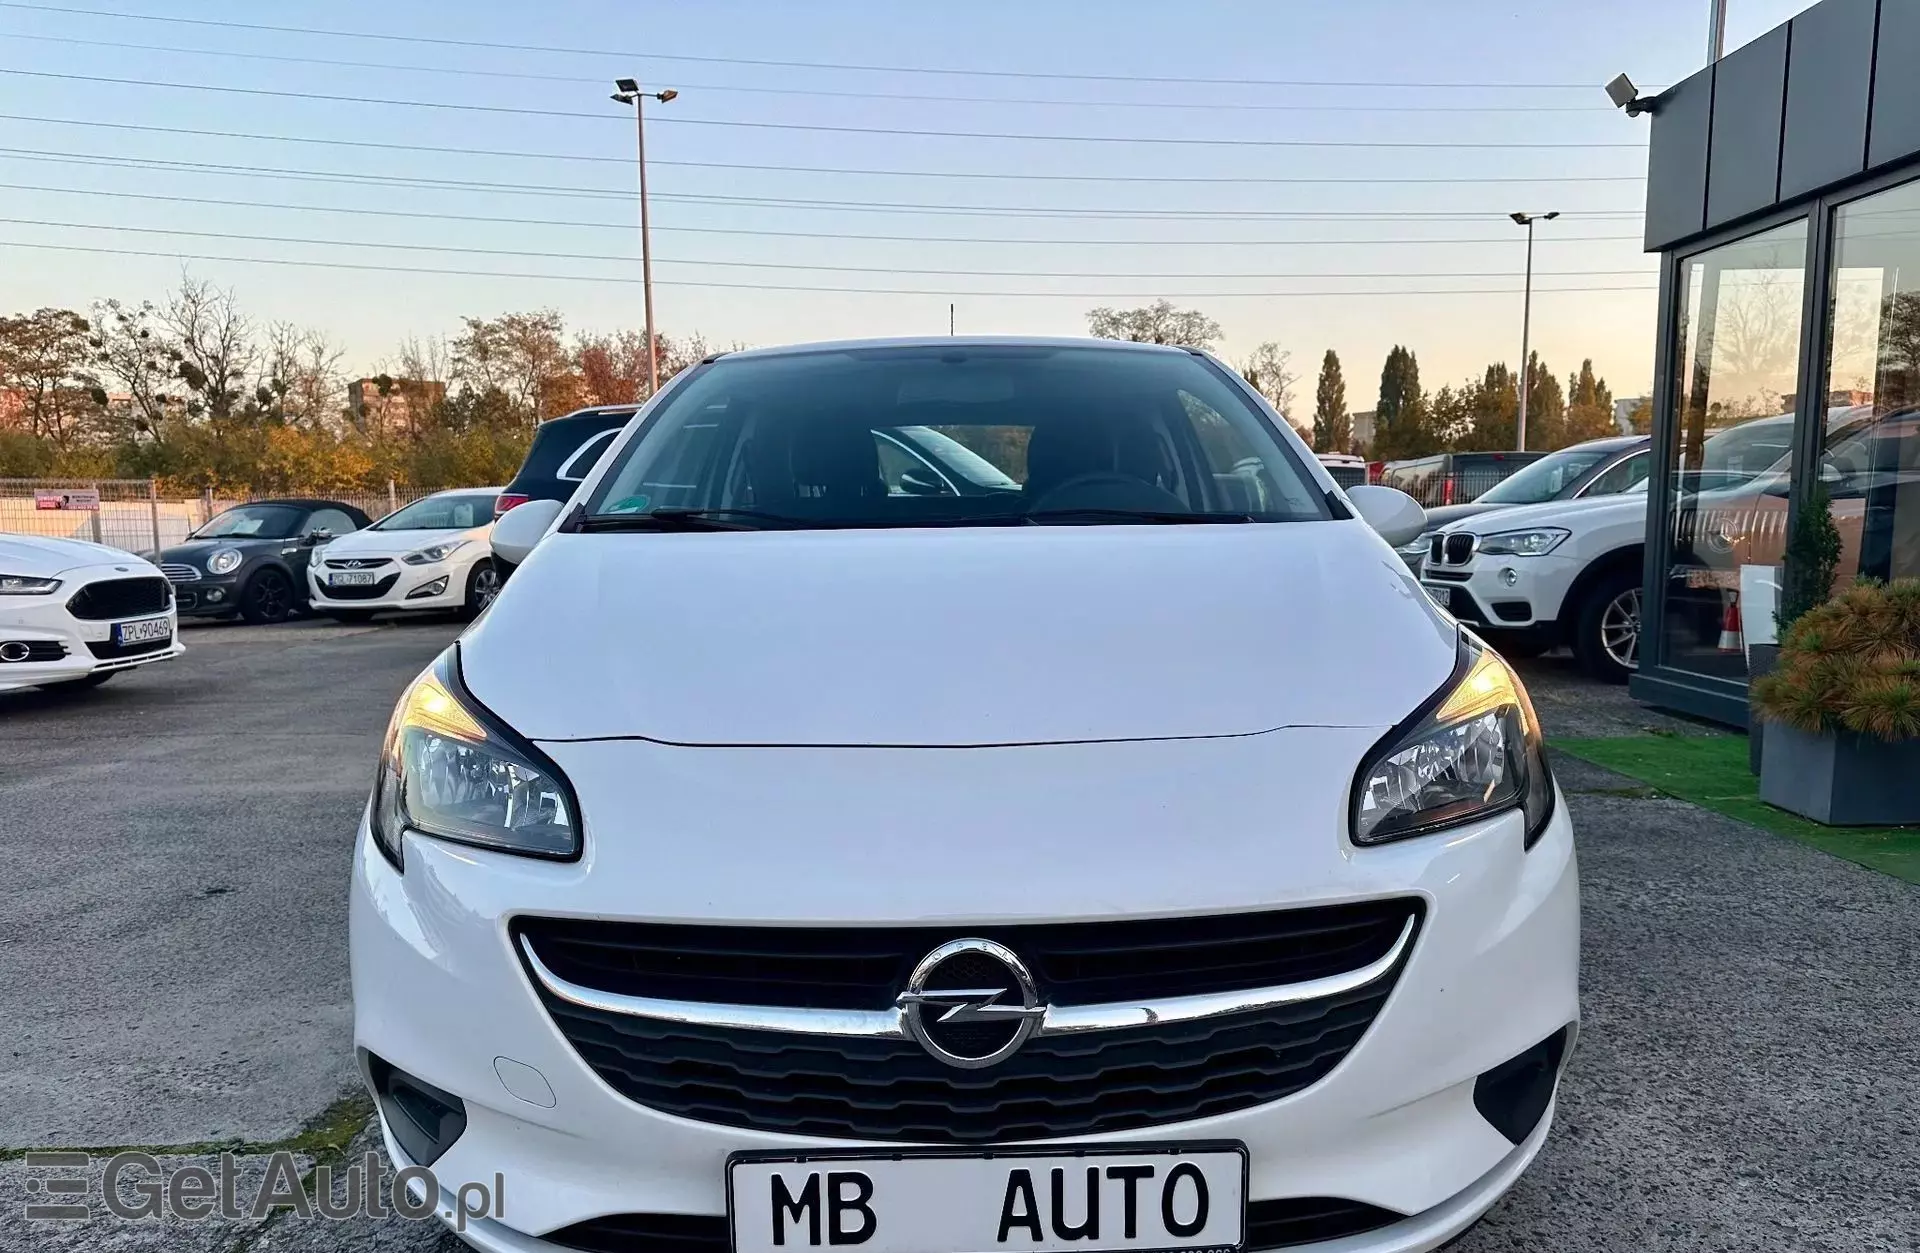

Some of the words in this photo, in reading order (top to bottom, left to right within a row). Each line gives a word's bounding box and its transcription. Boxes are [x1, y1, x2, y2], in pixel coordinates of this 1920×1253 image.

[122, 625, 140, 641] ZPL
[142, 620, 168, 638] 90469
[932, 943, 1009, 961] OPEL
[770, 1171, 877, 1246] MB
[996, 1161, 1210, 1243] AUTO
